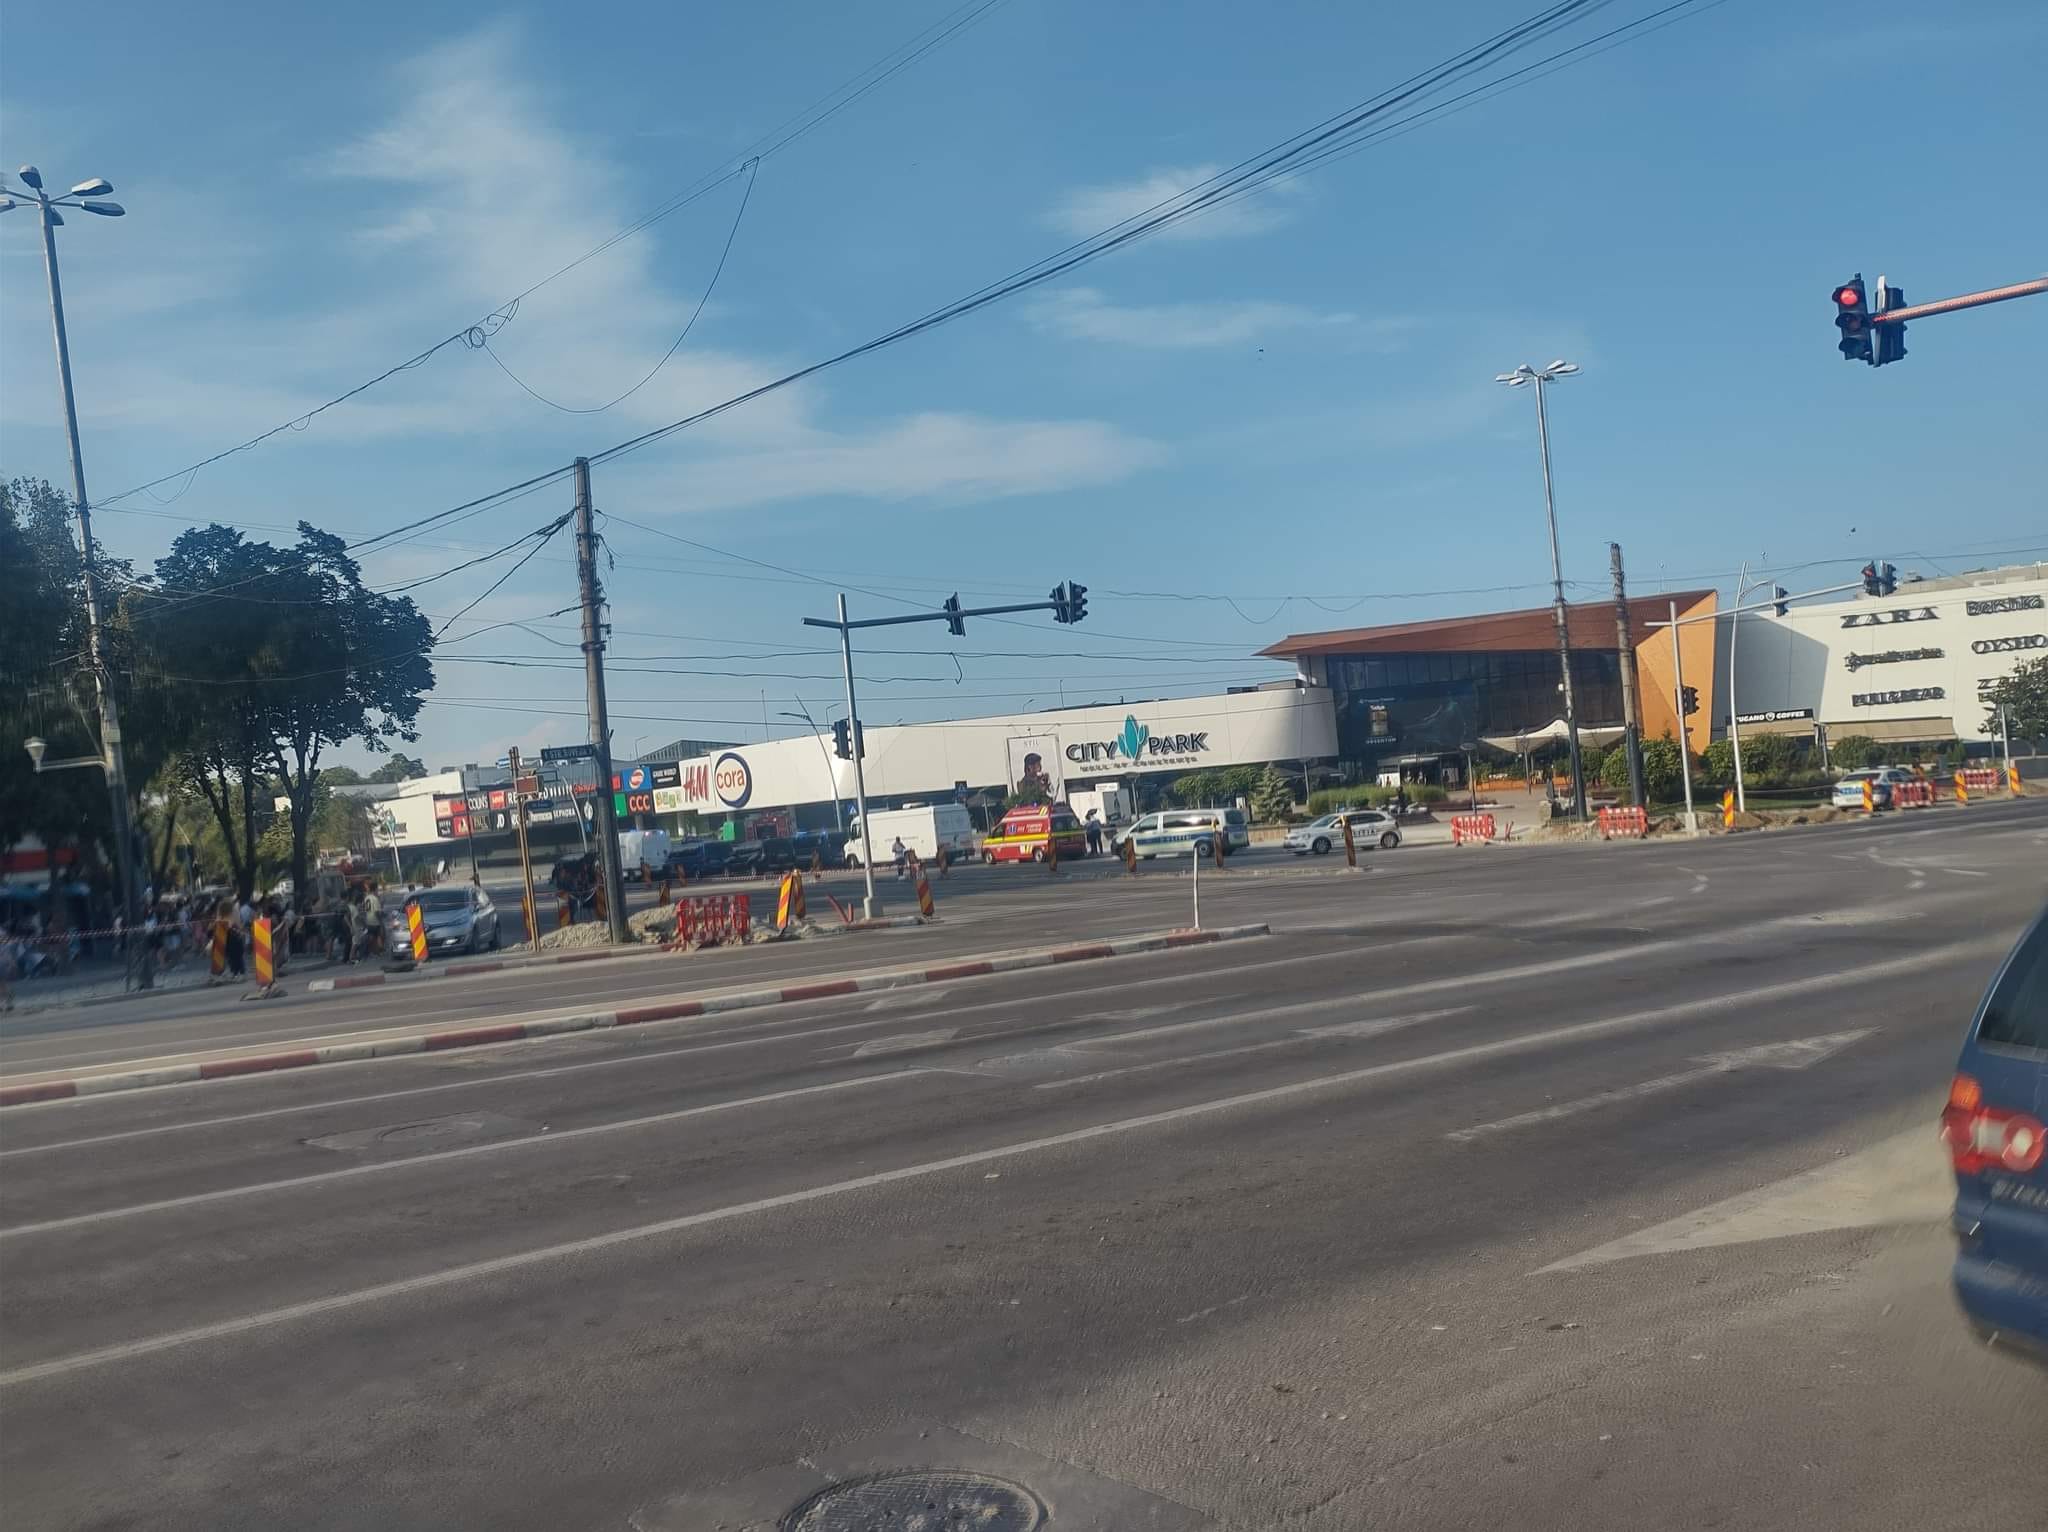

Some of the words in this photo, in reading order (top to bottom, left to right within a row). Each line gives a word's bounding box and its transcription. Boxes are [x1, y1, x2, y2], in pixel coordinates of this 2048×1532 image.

[1840, 606, 1940, 628] ZARA
[1972, 634, 2048, 654] OYSHO
[1065, 740, 1118, 763] CITY
[1148, 732, 1209, 756] PARK
[716, 767, 745, 789] cora
[629, 794, 650, 812] CCC
